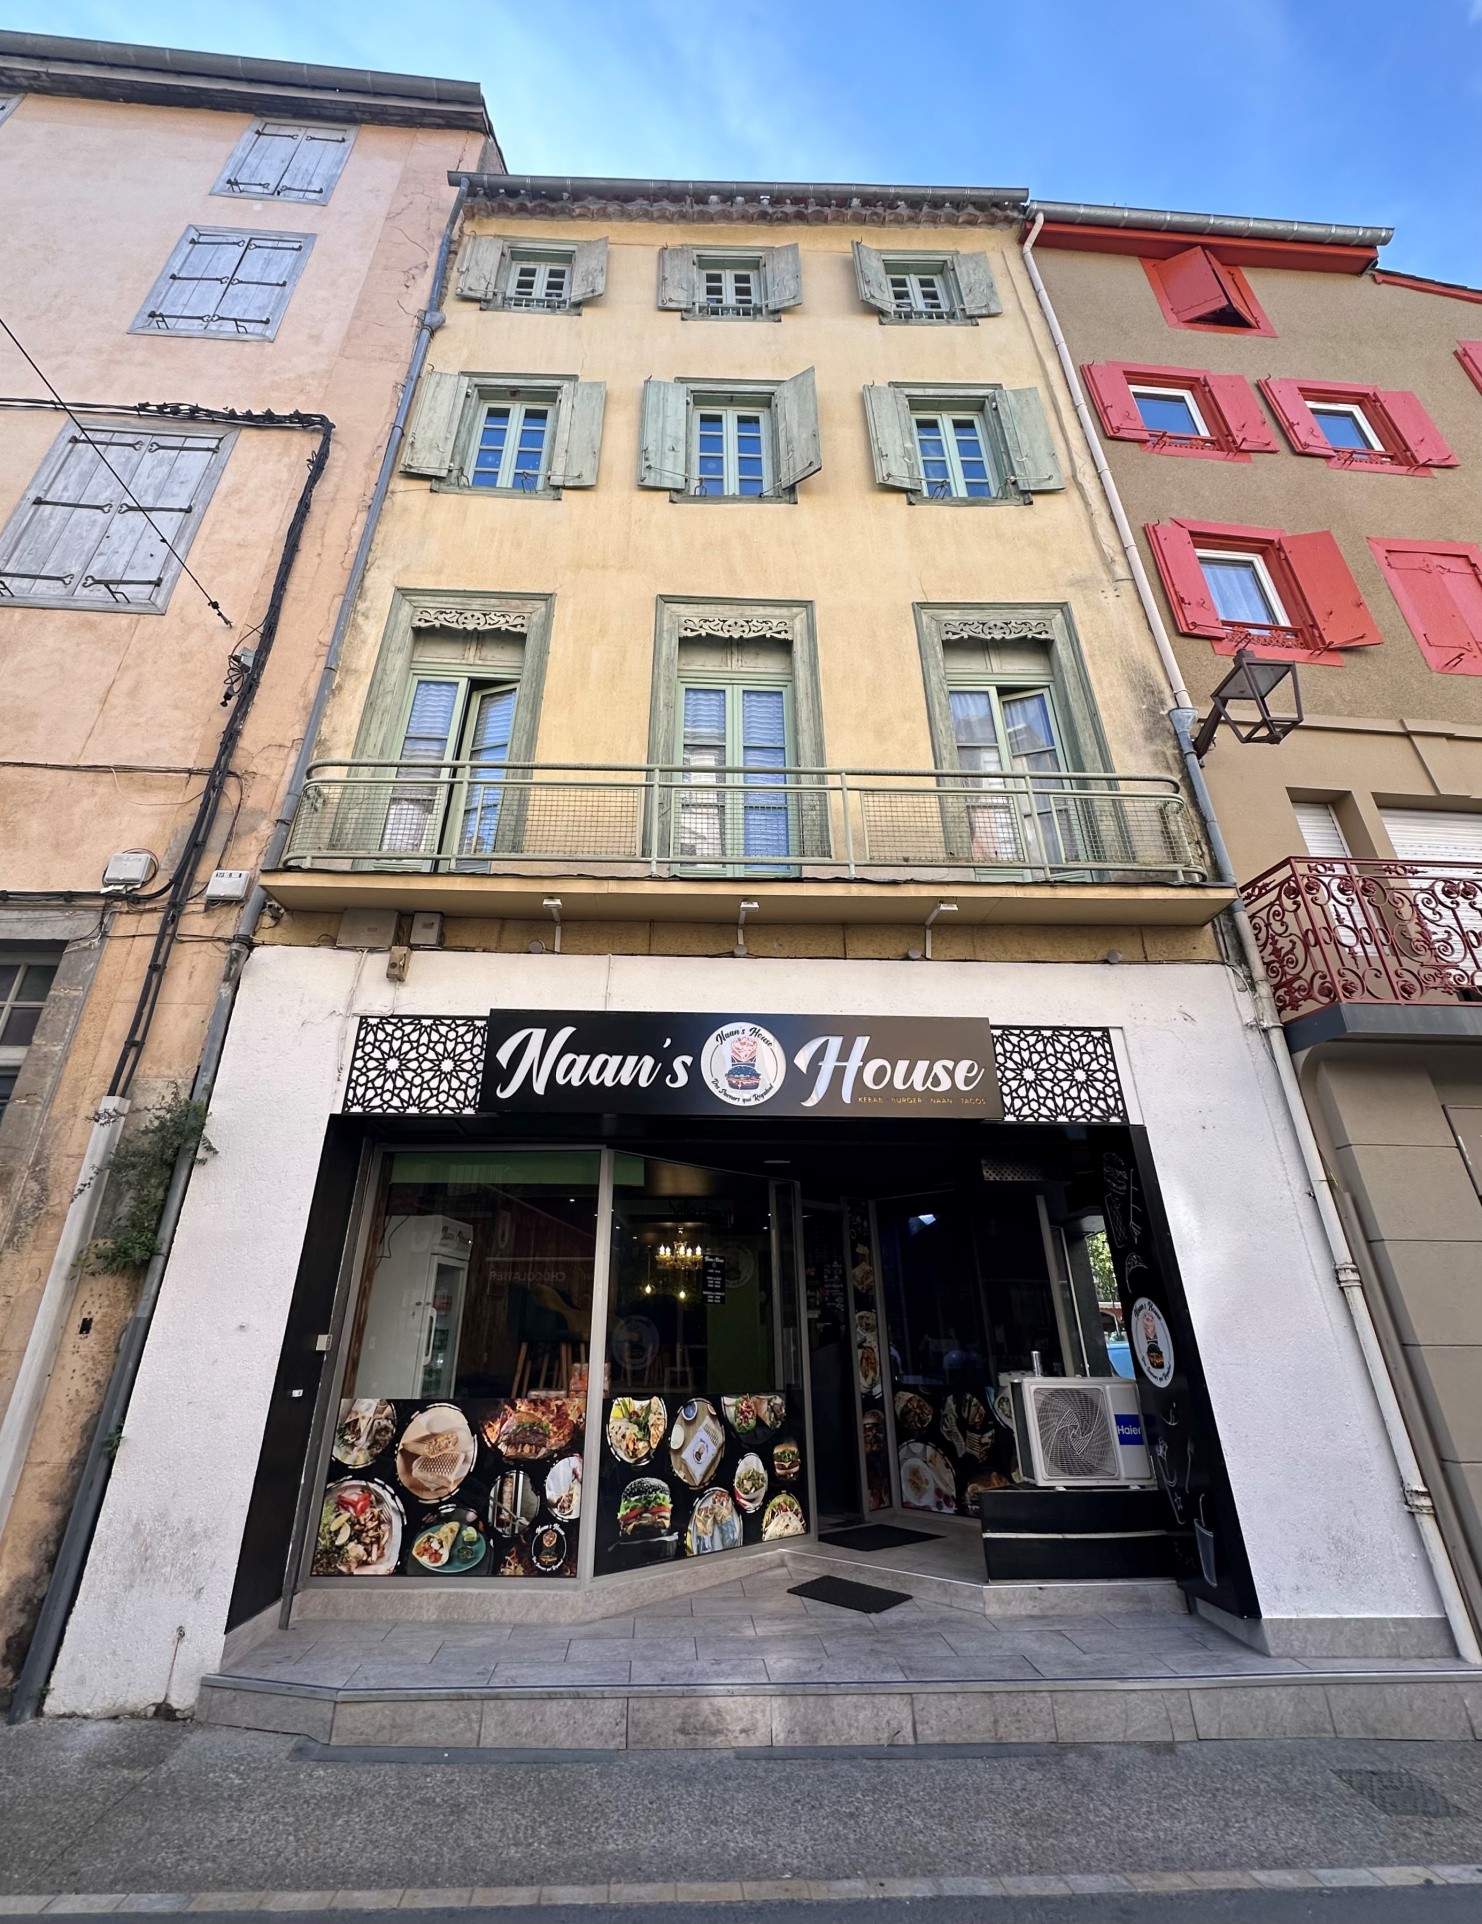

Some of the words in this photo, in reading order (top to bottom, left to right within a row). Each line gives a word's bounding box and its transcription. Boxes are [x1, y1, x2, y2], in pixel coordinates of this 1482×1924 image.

[715, 1026, 746, 1045] Naan's
[749, 1026, 773, 1047] House
[495, 1026, 694, 1099] Naan's
[793, 1035, 985, 1107] House
[930, 1097, 953, 1105] NAAN
[961, 1097, 987, 1105] TACOS
[1117, 1425, 1141, 1435] Haier
